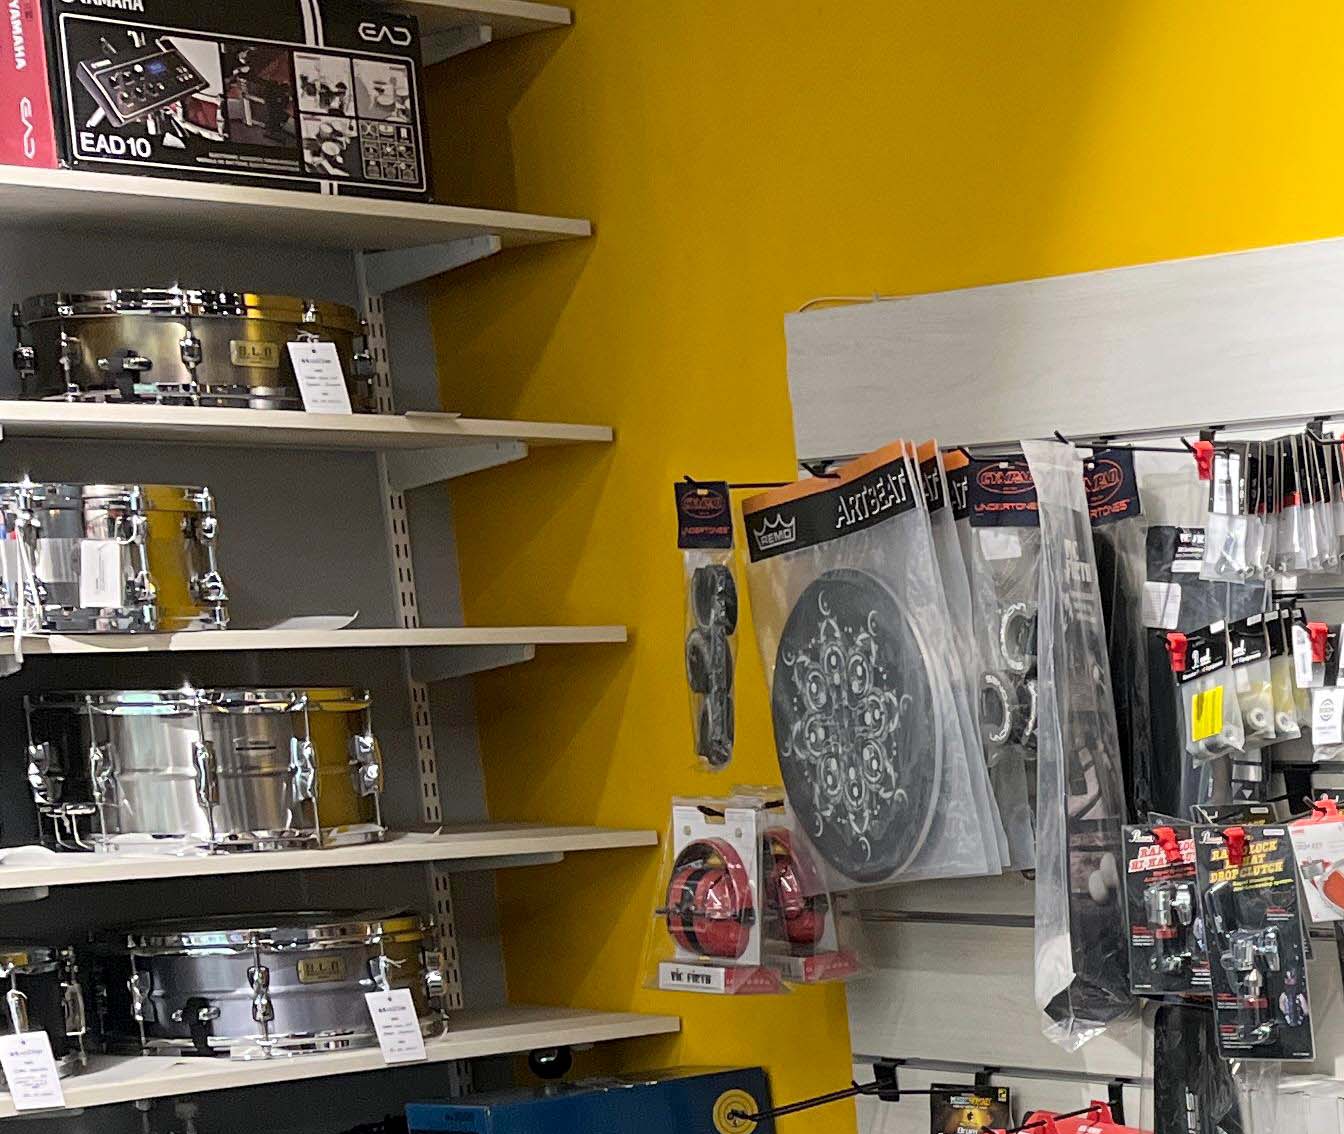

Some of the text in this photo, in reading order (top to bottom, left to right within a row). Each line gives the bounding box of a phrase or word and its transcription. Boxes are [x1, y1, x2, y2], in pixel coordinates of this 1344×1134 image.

[80, 131, 152, 158] EAD10
[835, 470, 907, 530] ARTBEAT
[761, 530, 791, 544] REMO
[1210, 862, 1283, 883] DROP CLUTCH
